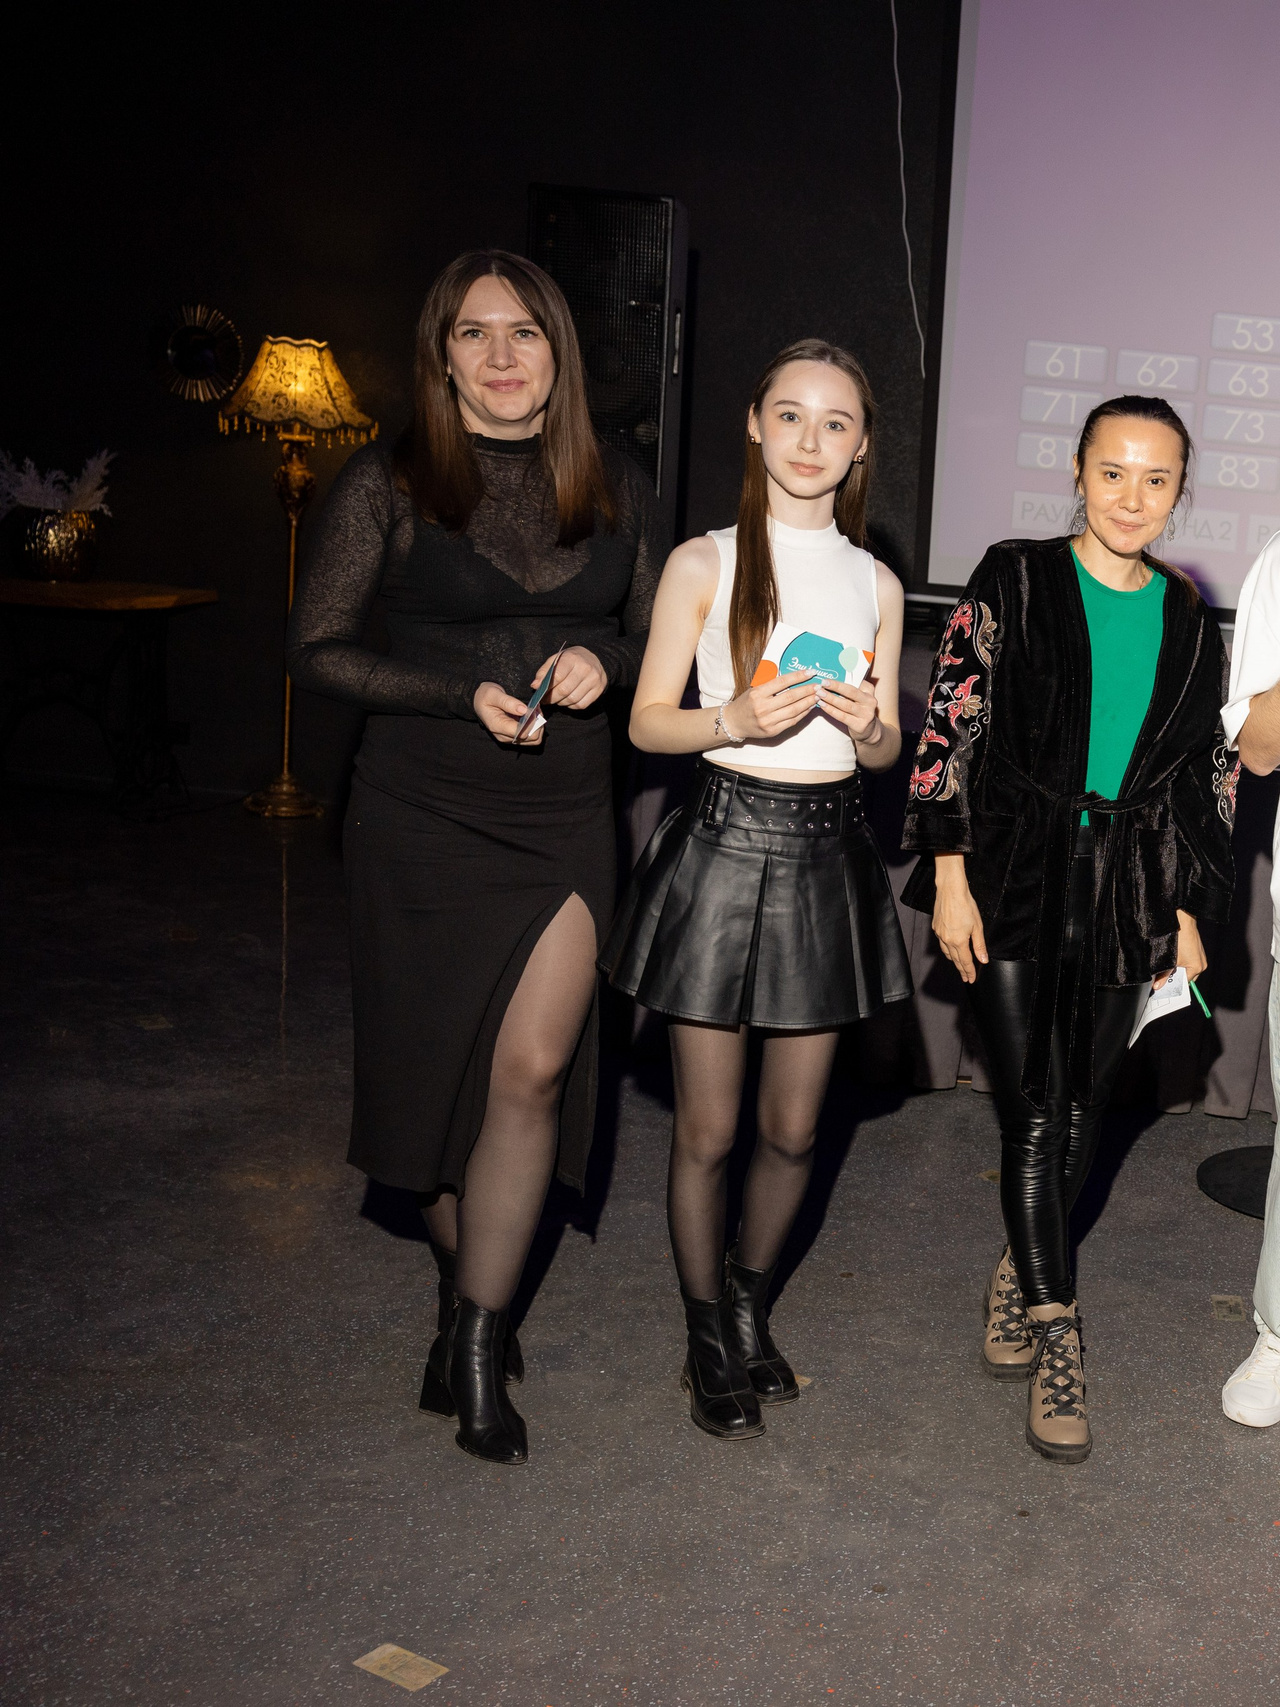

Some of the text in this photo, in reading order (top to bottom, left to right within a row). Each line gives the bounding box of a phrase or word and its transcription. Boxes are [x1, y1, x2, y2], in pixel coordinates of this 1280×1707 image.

[1231, 318, 1274, 352] 53
[1045, 346, 1082, 380] 61
[1137, 355, 1180, 389] 62
[1227, 364, 1270, 399] 63
[1042, 391, 1077, 425] 71
[1224, 409, 1265, 443] 73
[1036, 436, 1074, 470] 81
[1217, 455, 1260, 490] 83
[1021, 501, 1069, 525] РАУ
[787, 656, 835, 680] Эпишка
